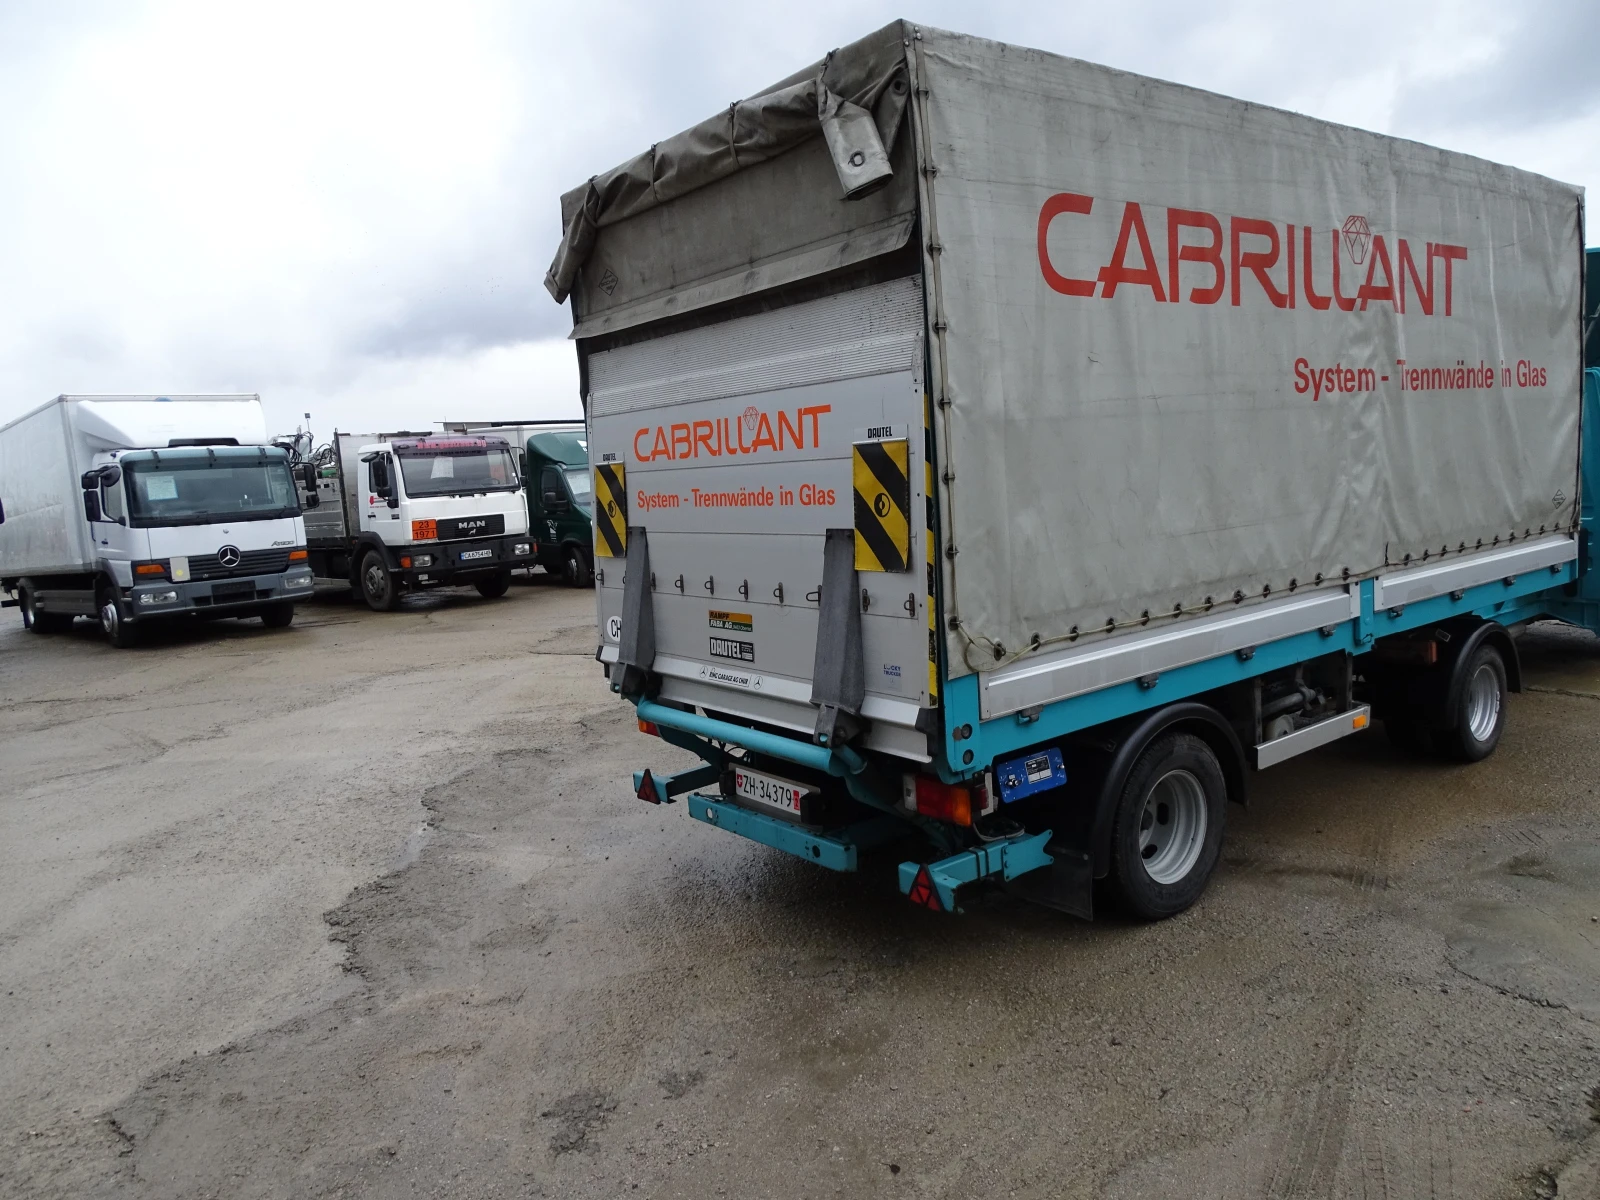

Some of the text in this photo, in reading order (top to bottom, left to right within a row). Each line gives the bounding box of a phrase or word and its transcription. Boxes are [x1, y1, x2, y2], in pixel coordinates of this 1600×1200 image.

[1037, 193, 1467, 316] CABRILLANT
[1294, 357, 1376, 401] System
[1397, 359, 1494, 391] Trennwände
[1501, 359, 1511, 387] in
[1516, 359, 1547, 387] Glas
[634, 404, 831, 463] CABRILLANT
[867, 425, 893, 439] DAUTEL
[638, 490, 680, 512] System
[691, 486, 774, 507] Trennwände
[779, 485, 794, 506] in
[799, 483, 836, 506] Glas
[415, 530, 436, 539] 1971
[418, 520, 430, 529] 23
[458, 520, 486, 529] MAN
[611, 619, 622, 638] CH
[710, 638, 742, 660] DAUTEL
